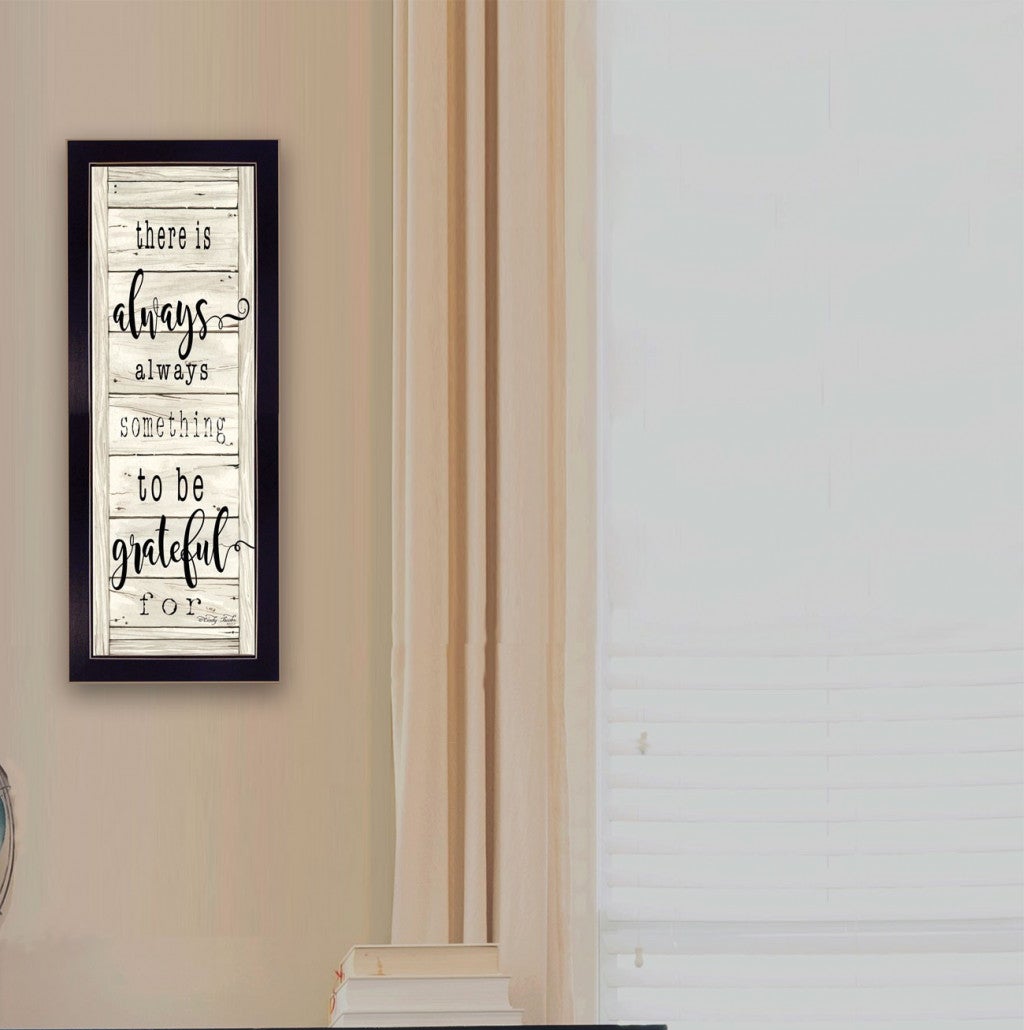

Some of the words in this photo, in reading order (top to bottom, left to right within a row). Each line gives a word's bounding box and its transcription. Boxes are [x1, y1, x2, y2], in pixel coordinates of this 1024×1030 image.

[136, 220, 187, 250] there
[195, 220, 211, 250] is
[112, 268, 250, 360] always
[135, 359, 209, 385] always
[120, 410, 226, 445] something
[137, 467, 163, 502] to
[175, 467, 204, 502] be
[111, 505, 255, 590] grateful
[140, 592, 202, 616] for
